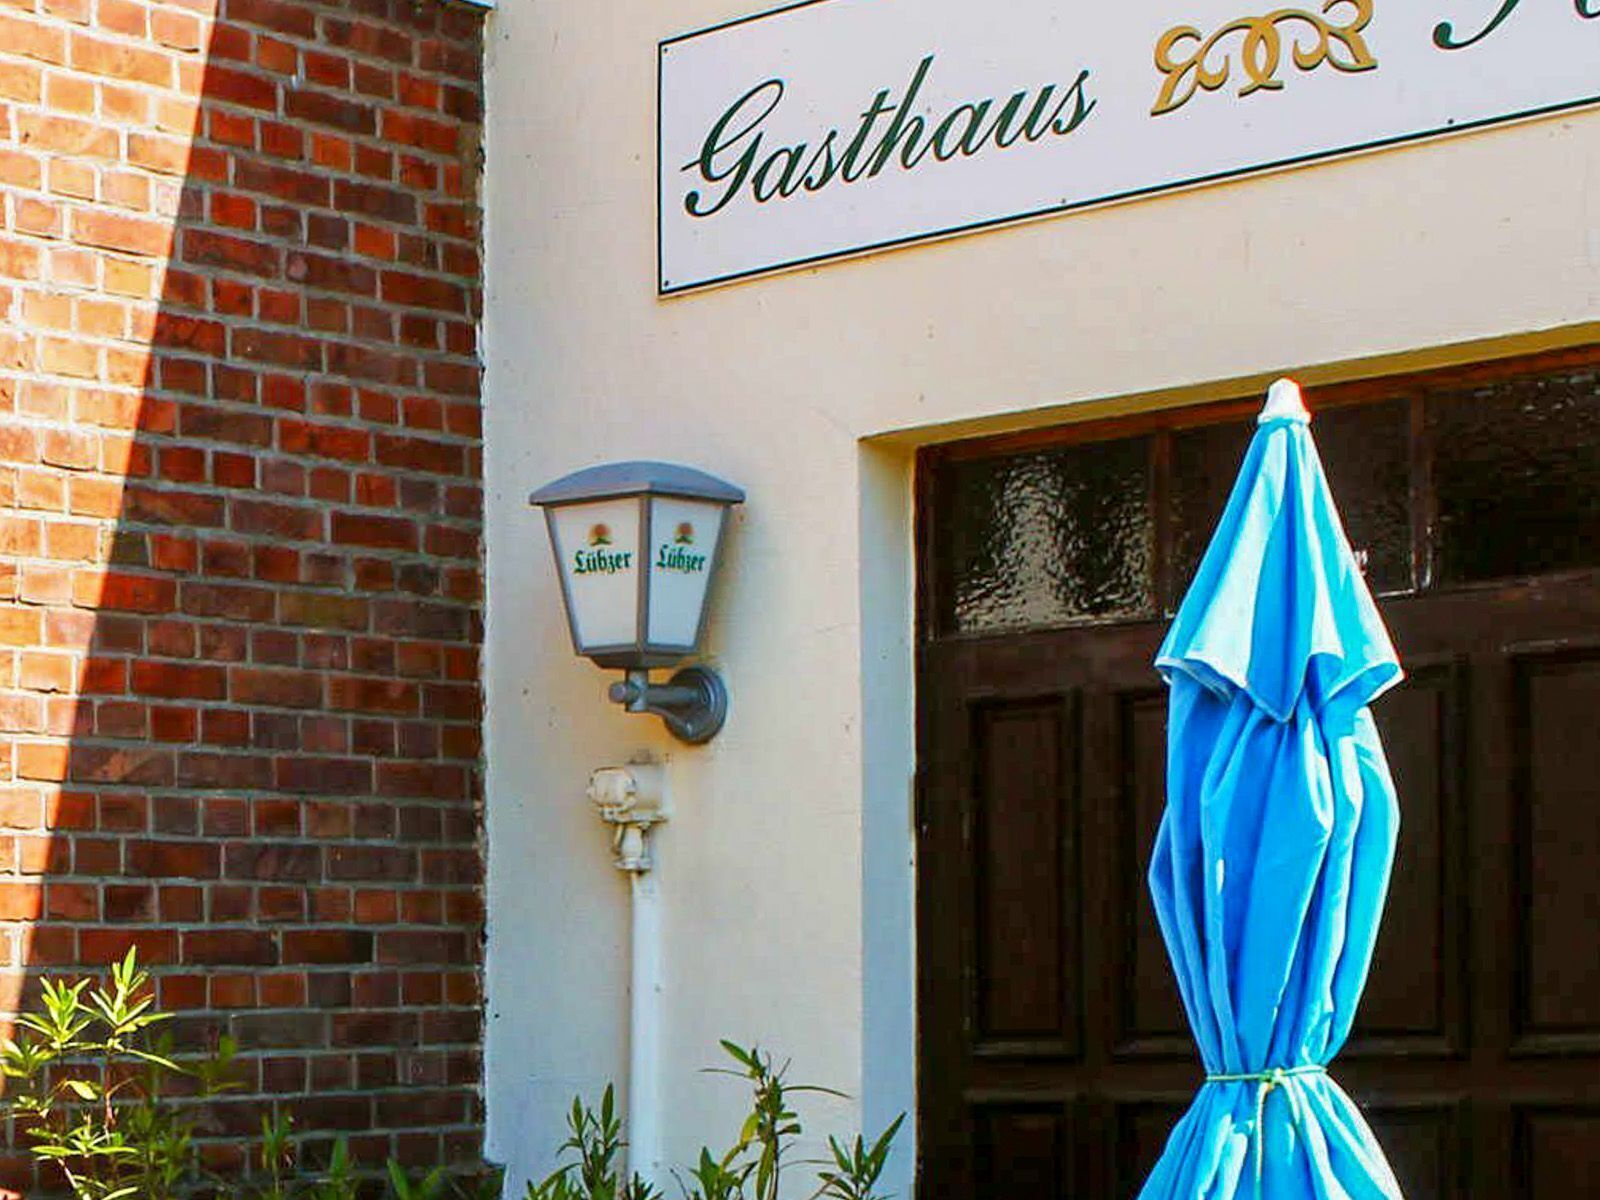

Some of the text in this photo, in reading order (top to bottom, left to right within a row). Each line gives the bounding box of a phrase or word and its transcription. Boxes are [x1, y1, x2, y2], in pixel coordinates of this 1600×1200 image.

[681, 55, 1096, 218] Gasthaus
[573, 549, 632, 575] Lübzer
[656, 544, 706, 575] Lübzer
